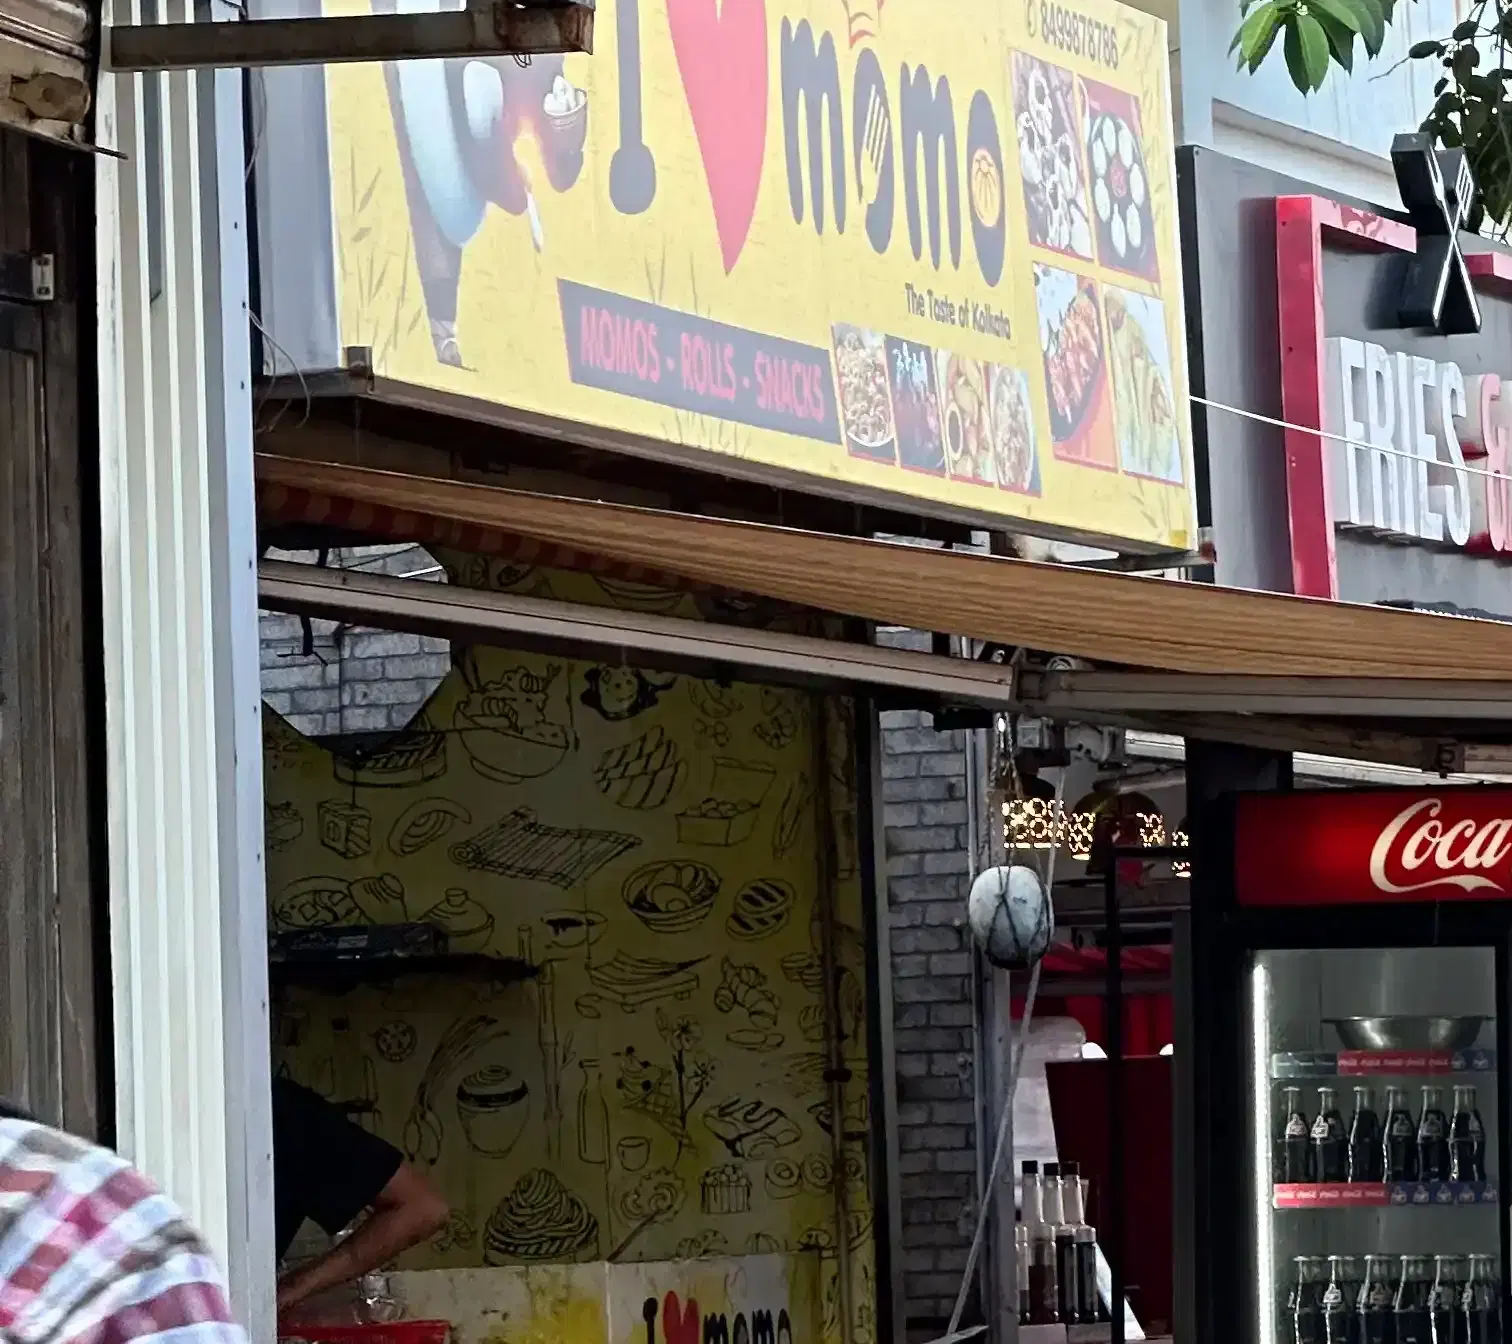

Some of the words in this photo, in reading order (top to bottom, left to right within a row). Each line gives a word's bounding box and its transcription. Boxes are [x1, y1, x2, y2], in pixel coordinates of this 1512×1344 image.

[780, 14, 1007, 288] momo
[580, 306, 660, 384] MOMOS
[681, 332, 737, 402] ROLLS
[755, 351, 824, 423] SNACKS
[904, 282, 925, 317] The
[926, 288, 956, 325] Taste
[958, 297, 969, 328] of
[972, 300, 1011, 340] Kolkata
[1338, 336, 1471, 547] FRIES
